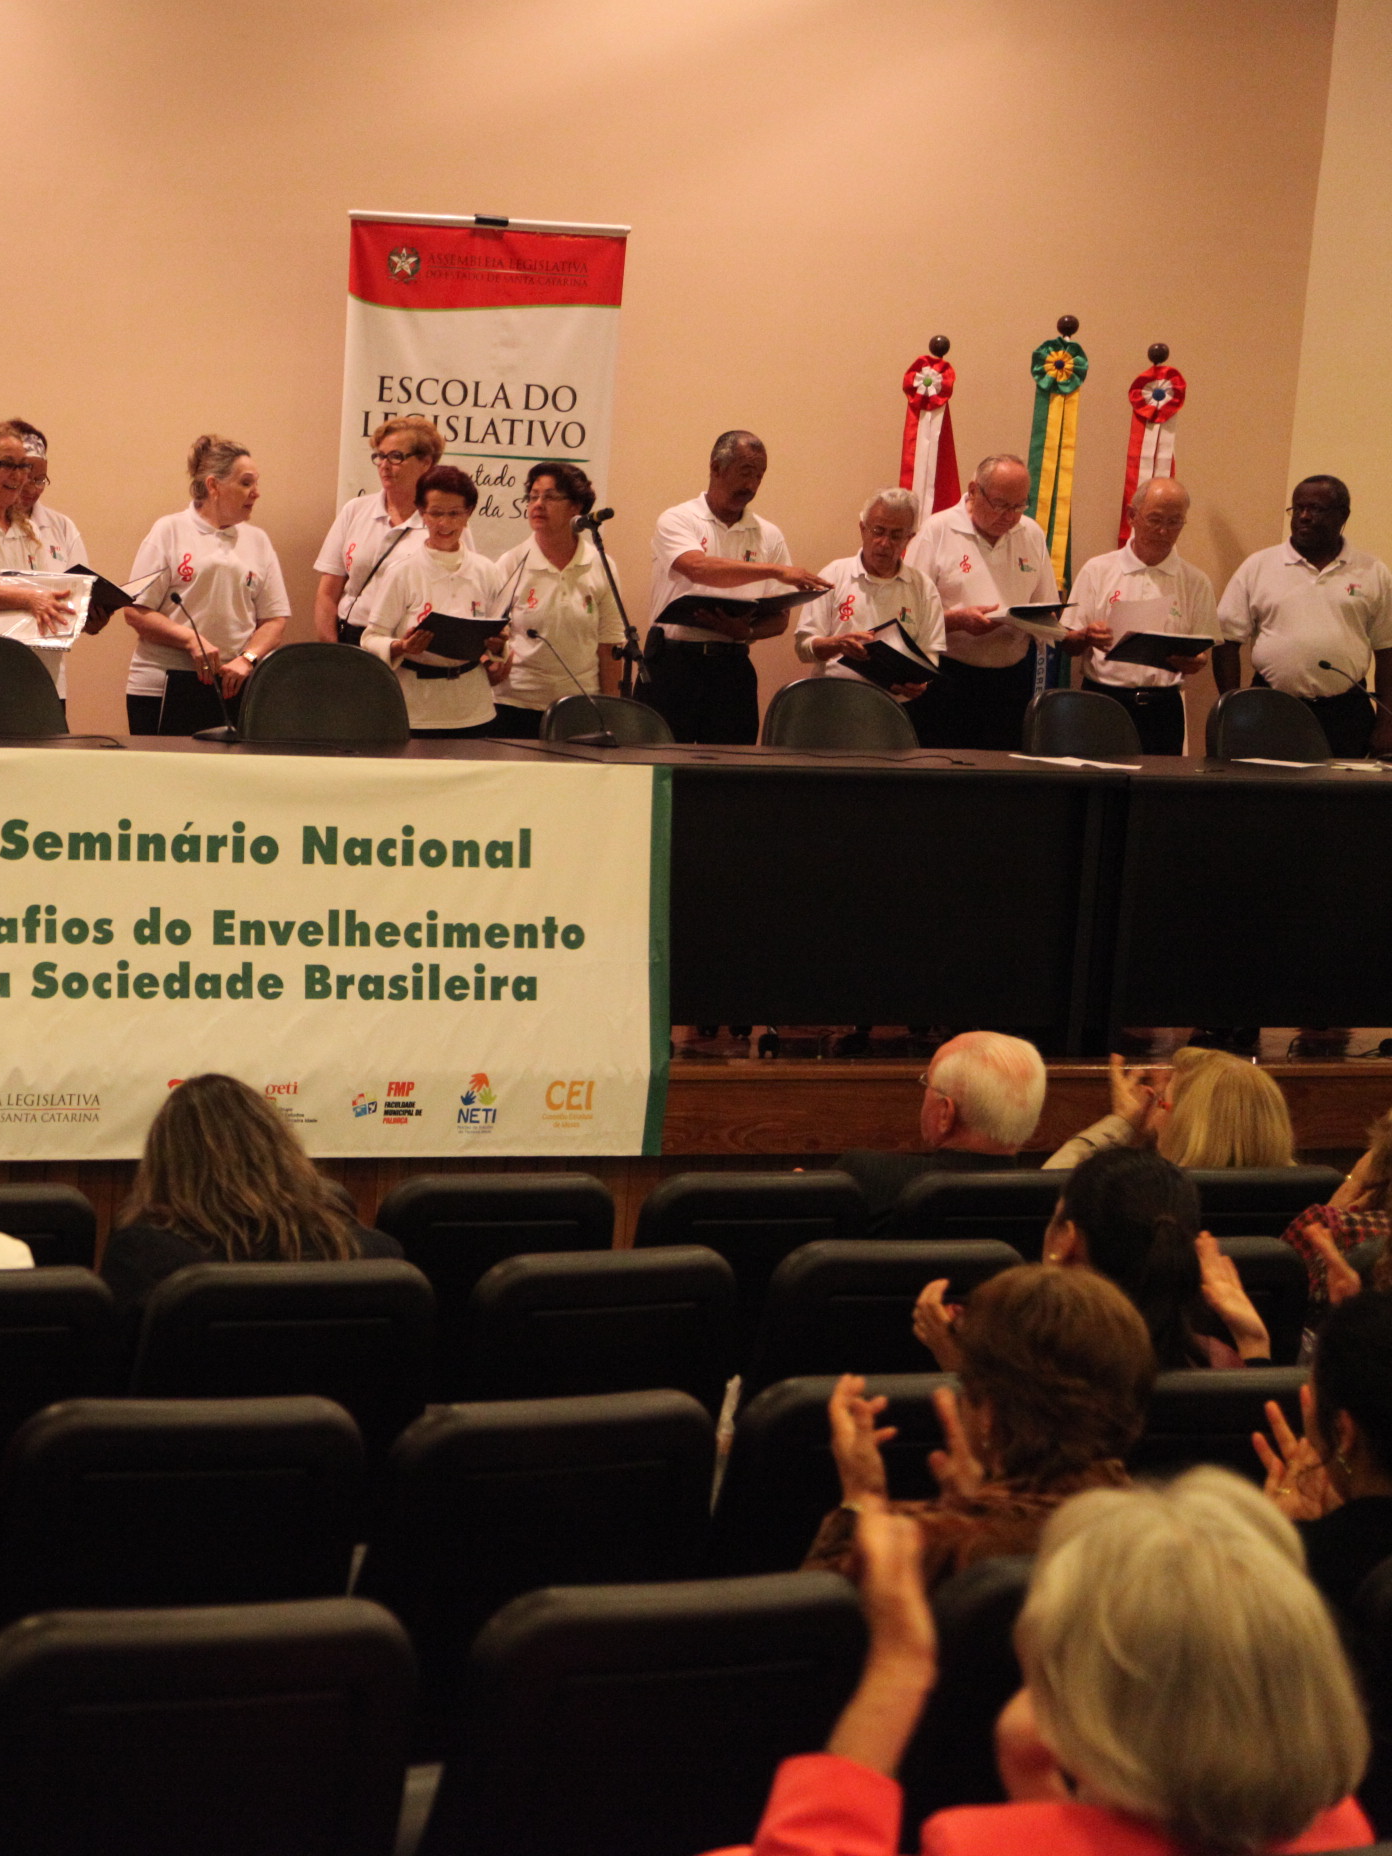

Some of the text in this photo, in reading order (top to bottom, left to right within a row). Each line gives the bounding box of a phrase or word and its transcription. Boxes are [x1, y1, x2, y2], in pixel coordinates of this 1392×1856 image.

[428, 253, 588, 273] ASSEMBLEIA LEGISLATIVA
[377, 375, 578, 413] ESCOLA DO
[361, 410, 587, 449] LISLATIVO
[0, 818, 279, 865] Seminário
[302, 825, 532, 869] Nacional
[133, 907, 192, 945] do
[212, 910, 586, 950] Envelhecimento
[31, 960, 285, 1000] Sociedade
[304, 963, 538, 1002] Brasileira
[7, 1093, 100, 1107] LEGISLATIVA
[387, 1081, 415, 1097] FMP
[545, 1080, 595, 1111] CEI
[0, 1112, 37, 1123] SANTA
[40, 1112, 100, 1124] CATARINA
[457, 1108, 497, 1124] NETI
